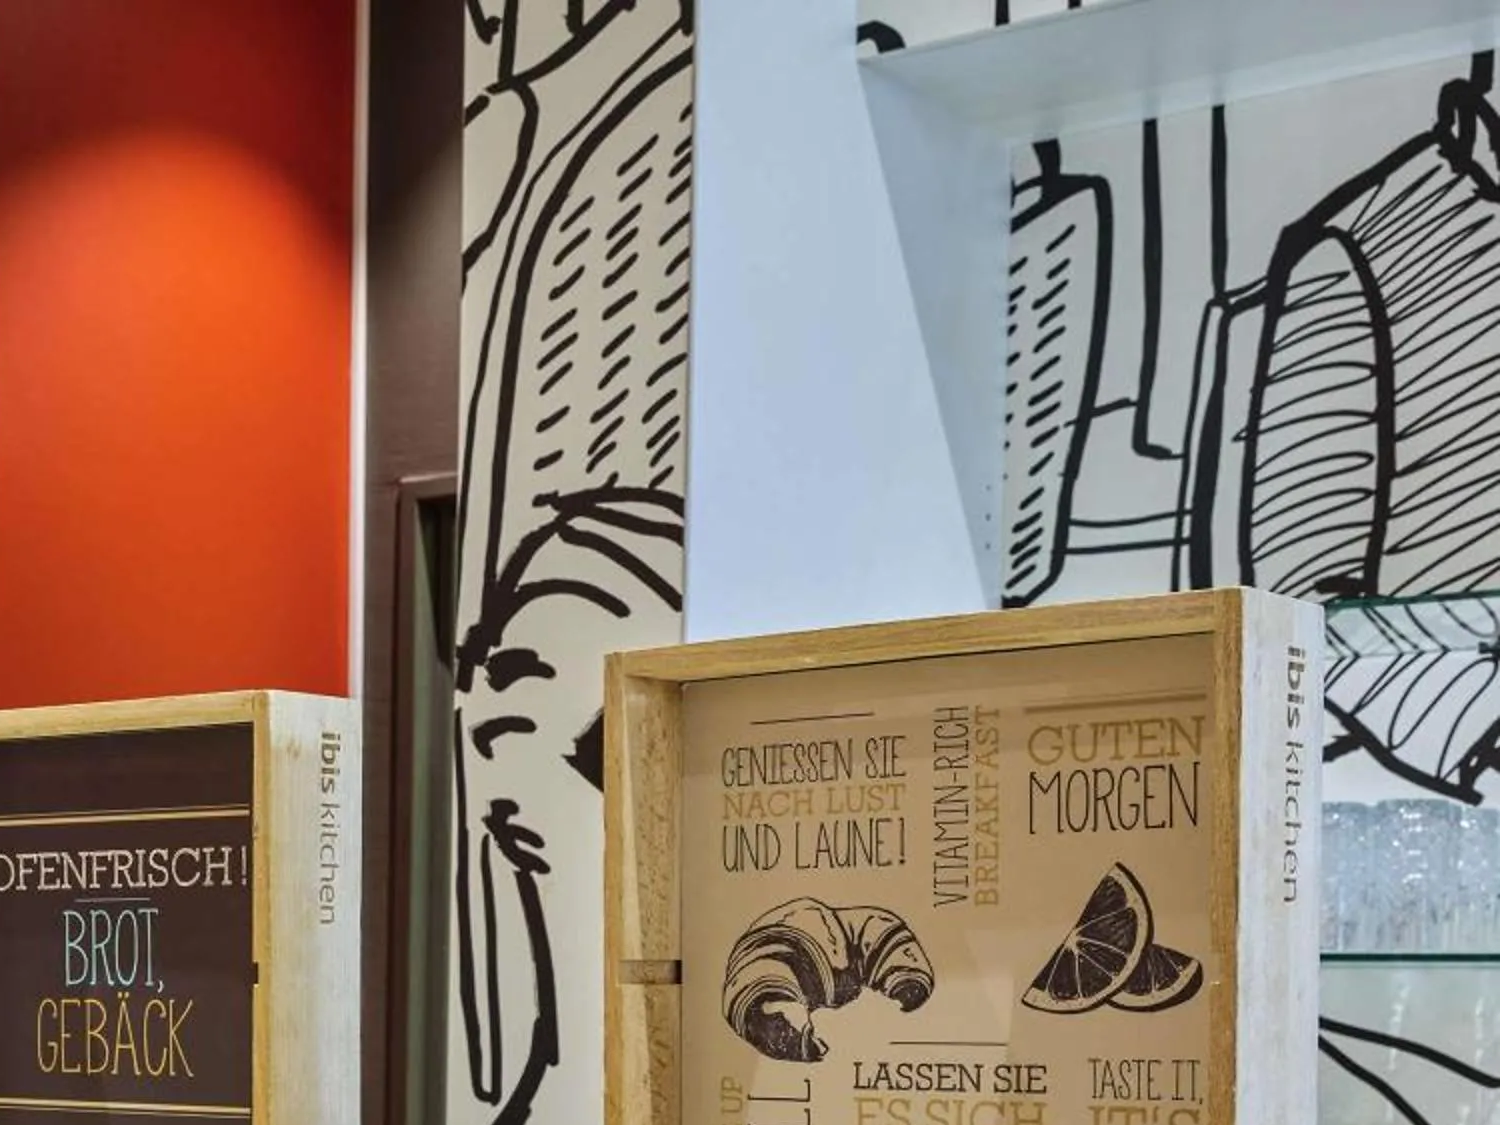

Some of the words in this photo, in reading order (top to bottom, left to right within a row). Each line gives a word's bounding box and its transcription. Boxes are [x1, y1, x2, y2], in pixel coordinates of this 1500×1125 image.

[1287, 646, 1305, 730] ibis
[321, 731, 341, 795] ibis
[721, 738, 853, 787] GENIESSEN
[865, 735, 906, 779] SIE
[1027, 715, 1206, 766] GUTEN
[722, 788, 814, 820] NACH
[827, 783, 906, 815] LUST
[933, 705, 969, 909] VITAMIN-RICH
[974, 705, 1000, 907] BREAKFAST
[1029, 761, 1201, 834] MORGEN
[1283, 741, 1304, 903] kitchen
[319, 803, 341, 925] kitchen
[722, 823, 781, 873] UND
[795, 817, 906, 870] LAUNE!
[63, 907, 165, 993] BROT,
[37, 992, 194, 1077] GEBÄCK
[721, 1076, 743, 1115] UP
[852, 1061, 984, 1093] LASSEN
[993, 1064, 1047, 1094] SIE
[1087, 1058, 1162, 1101] TASTE
[1171, 1058, 1203, 1105] IT,
